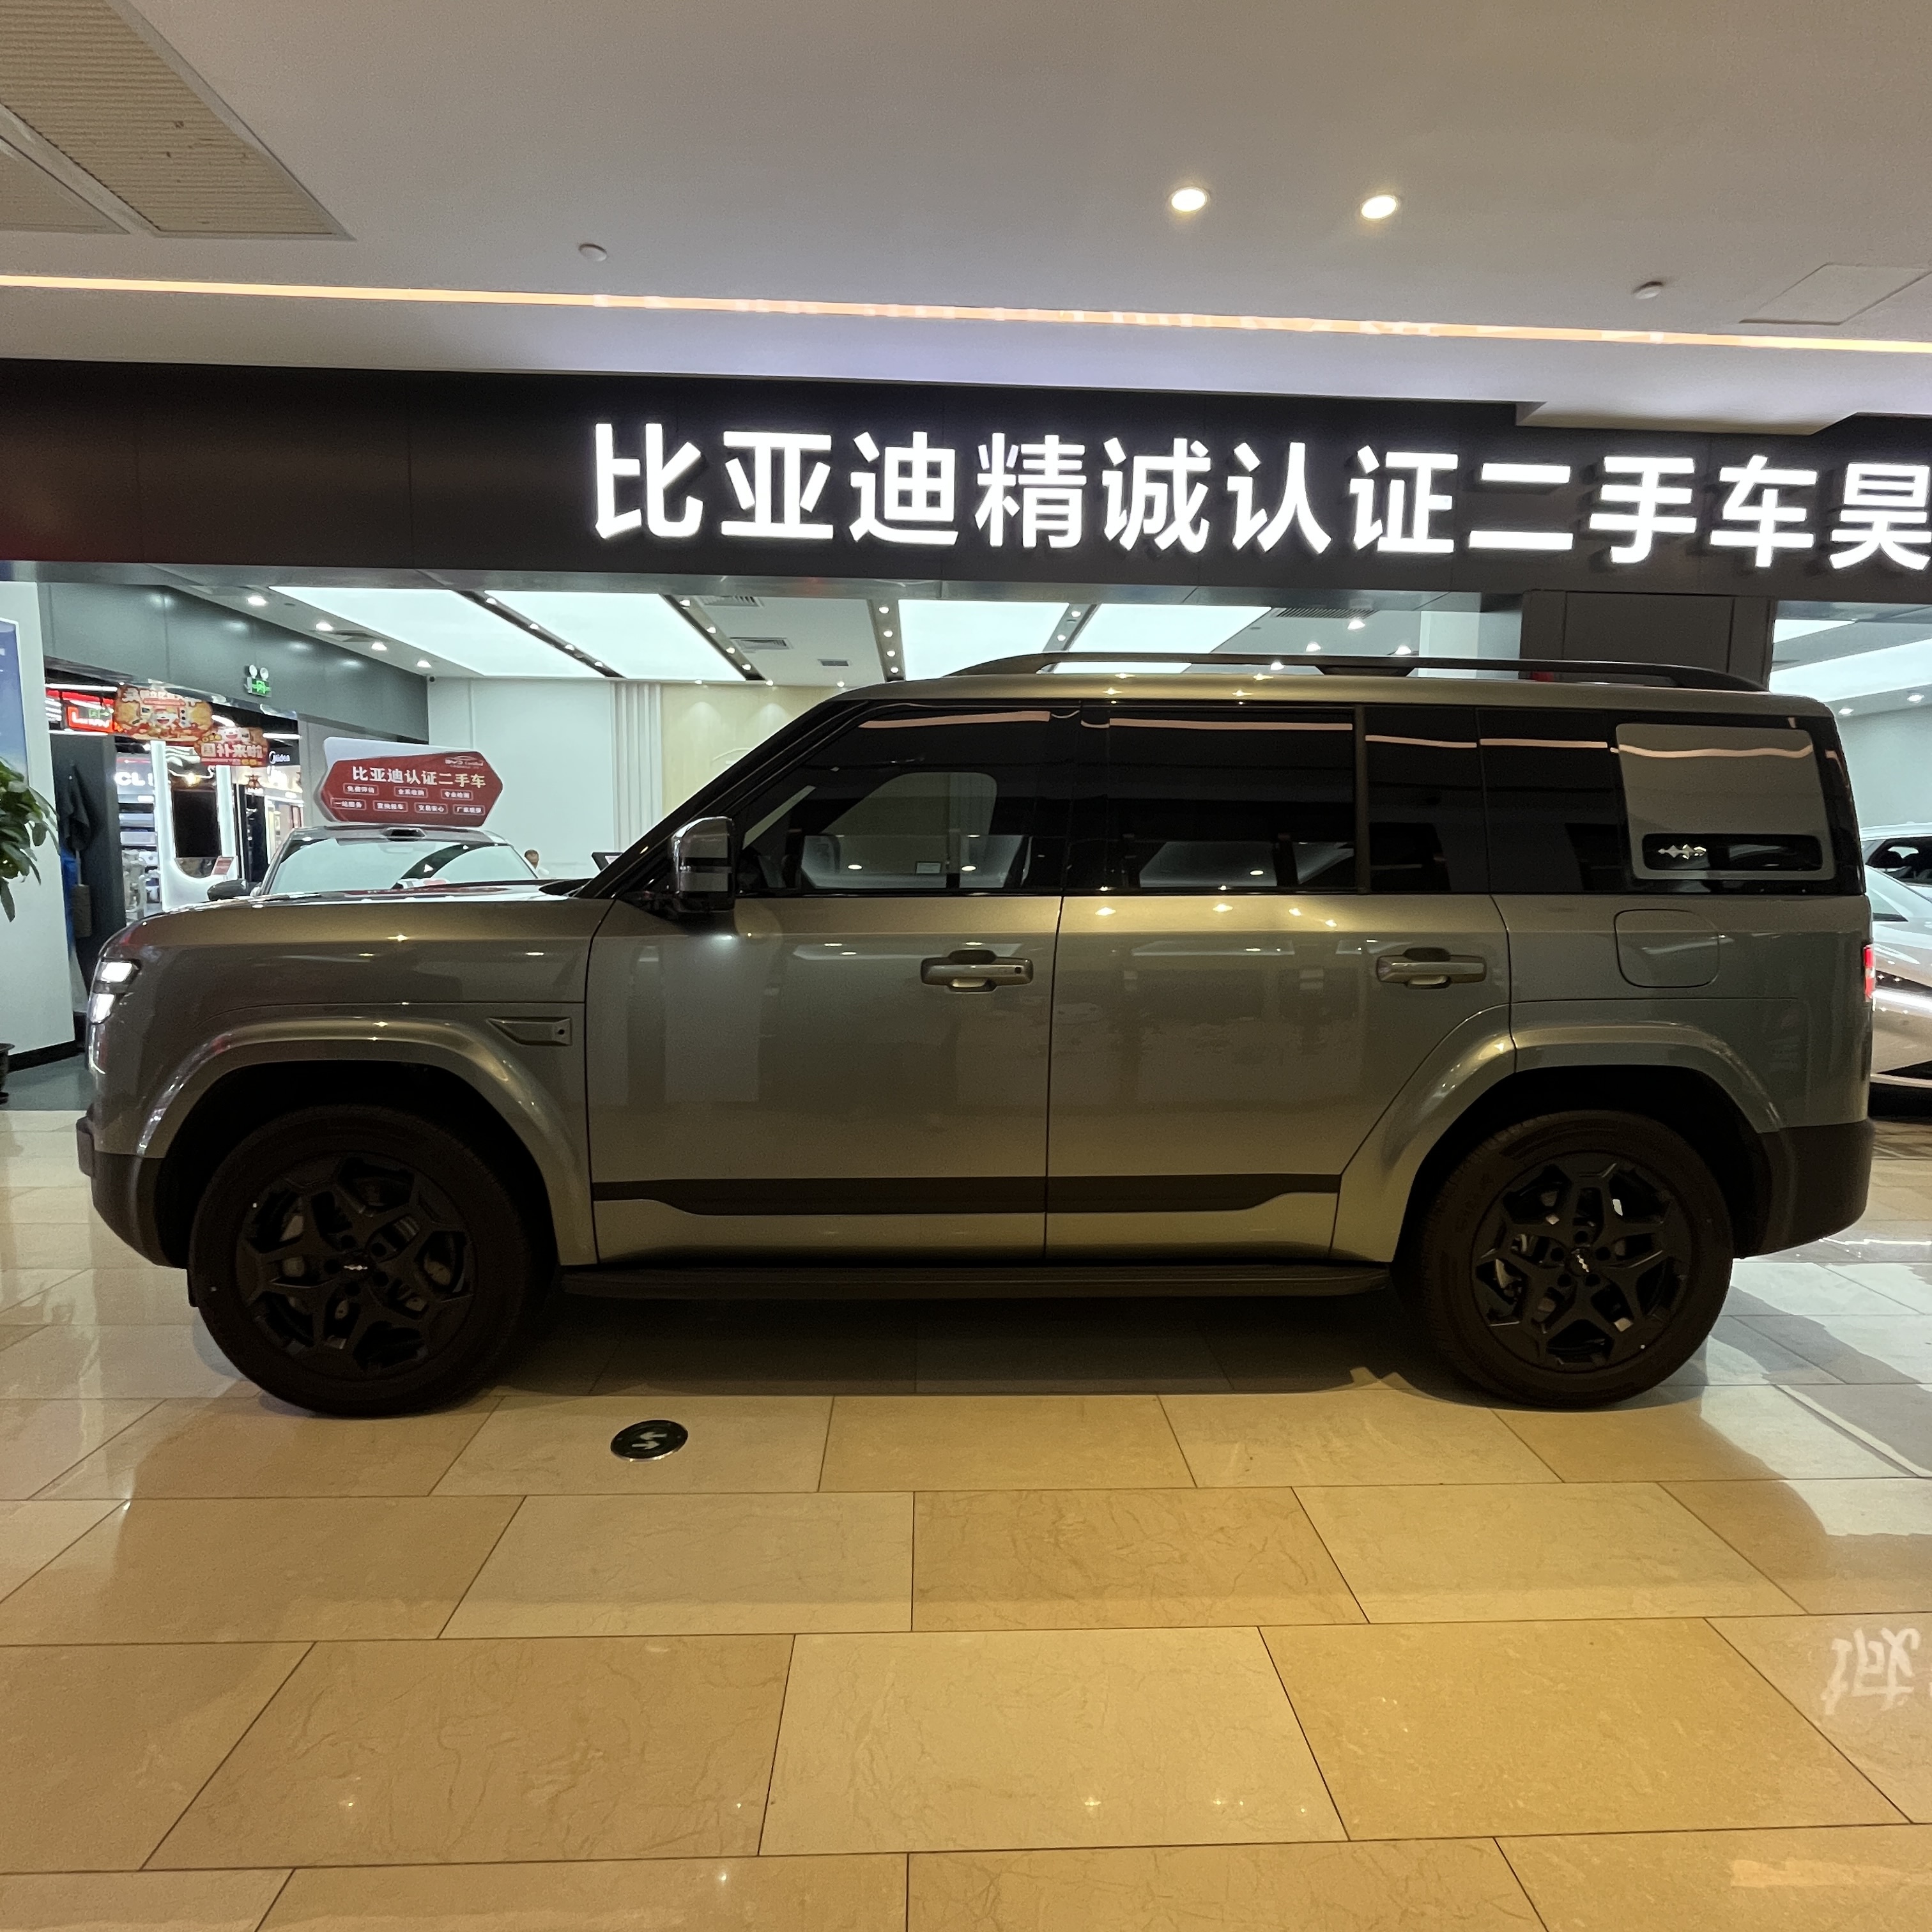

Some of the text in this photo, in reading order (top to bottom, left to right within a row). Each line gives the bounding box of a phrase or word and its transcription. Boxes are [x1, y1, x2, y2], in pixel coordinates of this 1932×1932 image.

[594, 422, 1932, 571] 比亚迪精诚认证二手车昊
[351, 766, 486, 788] 比亚迪认证二手车
